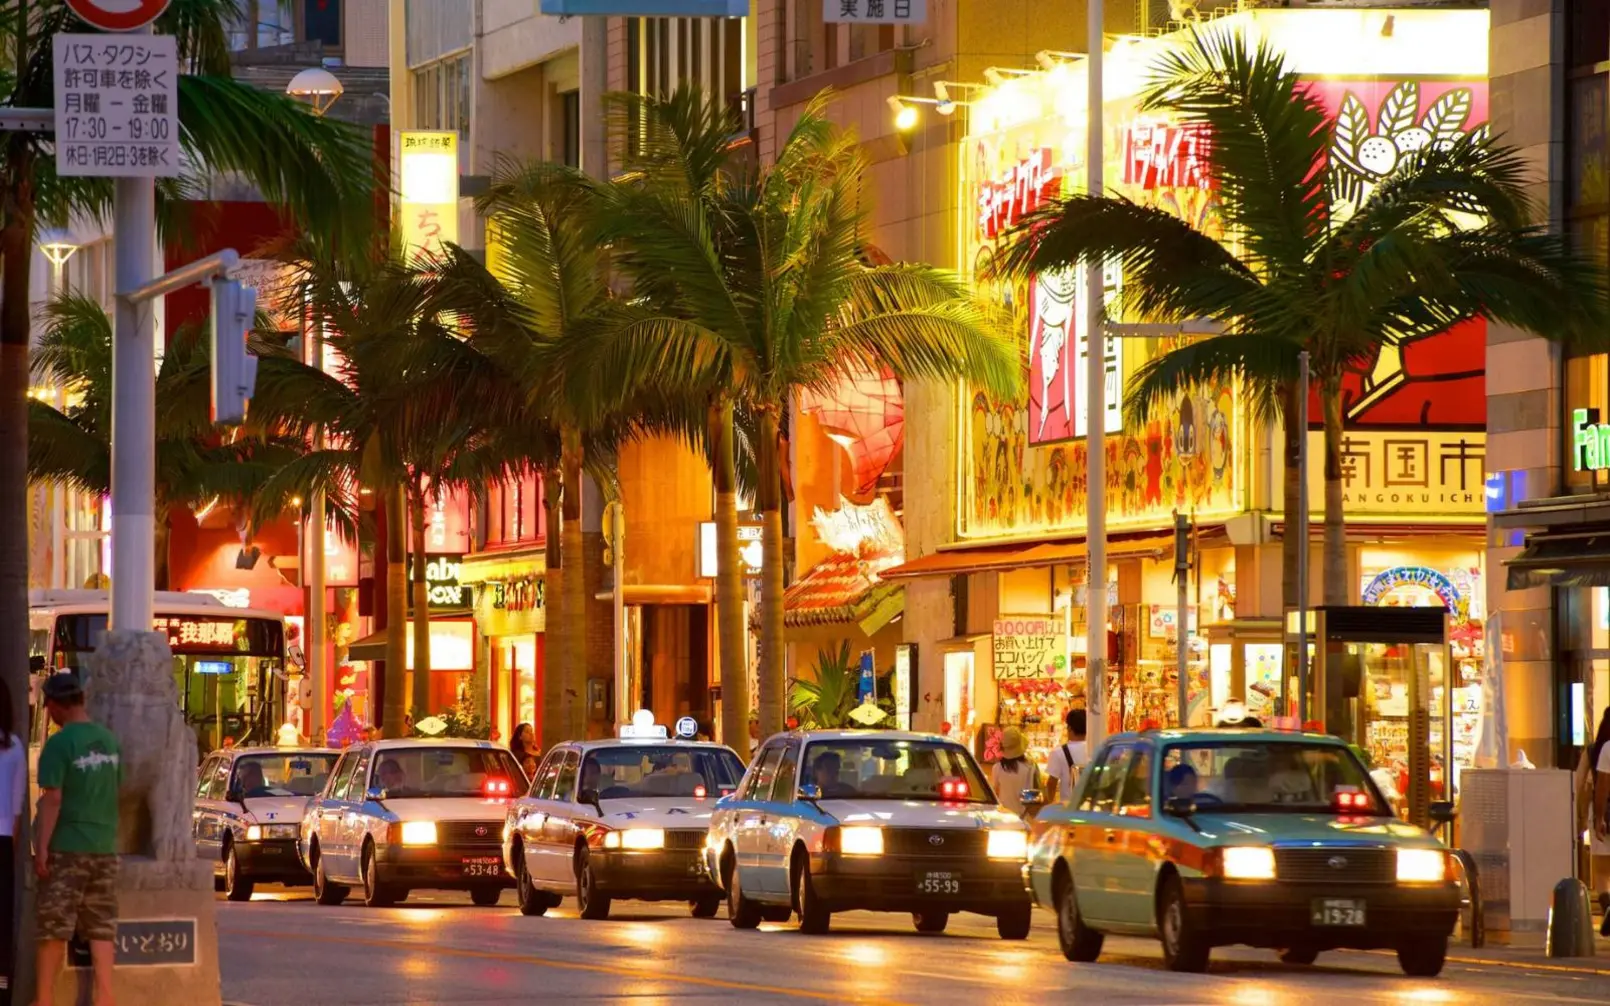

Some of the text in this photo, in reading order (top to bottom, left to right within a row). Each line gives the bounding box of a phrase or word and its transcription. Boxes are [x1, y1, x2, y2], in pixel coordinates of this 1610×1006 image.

[63, 44, 167, 65] バス・タクシー
[64, 68, 168, 90] 許可車を除く
[65, 93, 100, 114] 月曜
[131, 94, 168, 115] 金曜
[65, 117, 106, 139] 17:30
[128, 118, 169, 139] 19:00
[1342, 493, 1430, 503] ANGOKU
[994, 620, 1066, 636] 3000円以上
[924, 879, 960, 893] 55-99
[115, 932, 188, 954] いとおり
